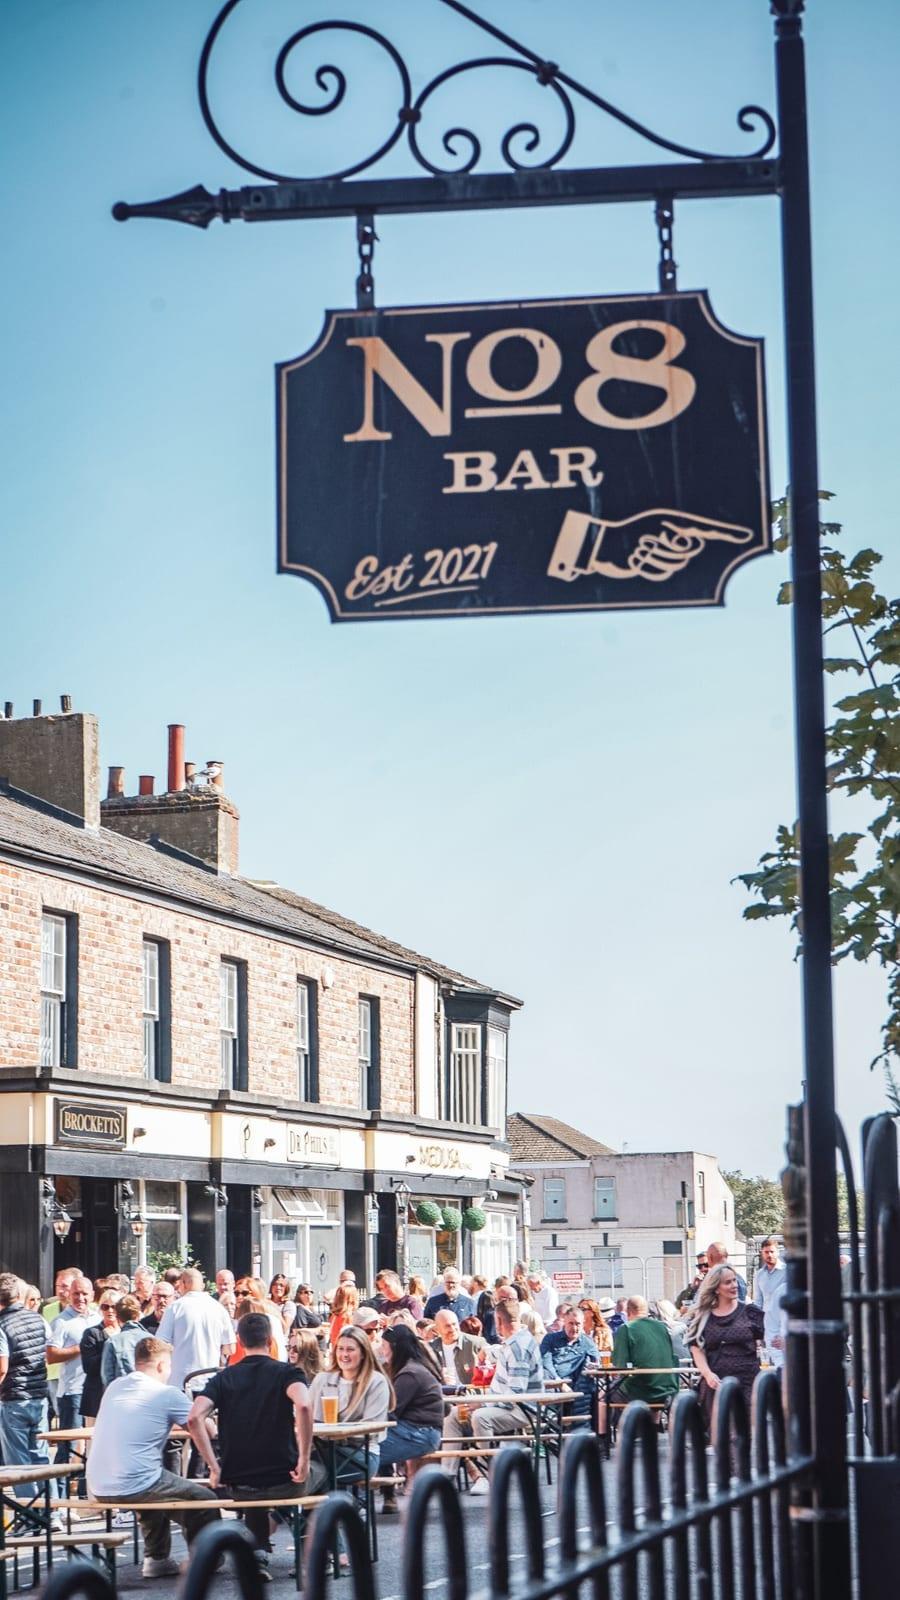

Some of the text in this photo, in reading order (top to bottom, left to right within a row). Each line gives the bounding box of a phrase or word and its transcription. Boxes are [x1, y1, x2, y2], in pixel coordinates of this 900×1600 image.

[442, 446, 604, 494] BAR
[345, 541, 498, 602] Est 2021
[64, 1111, 120, 1134] BROCKETTS
